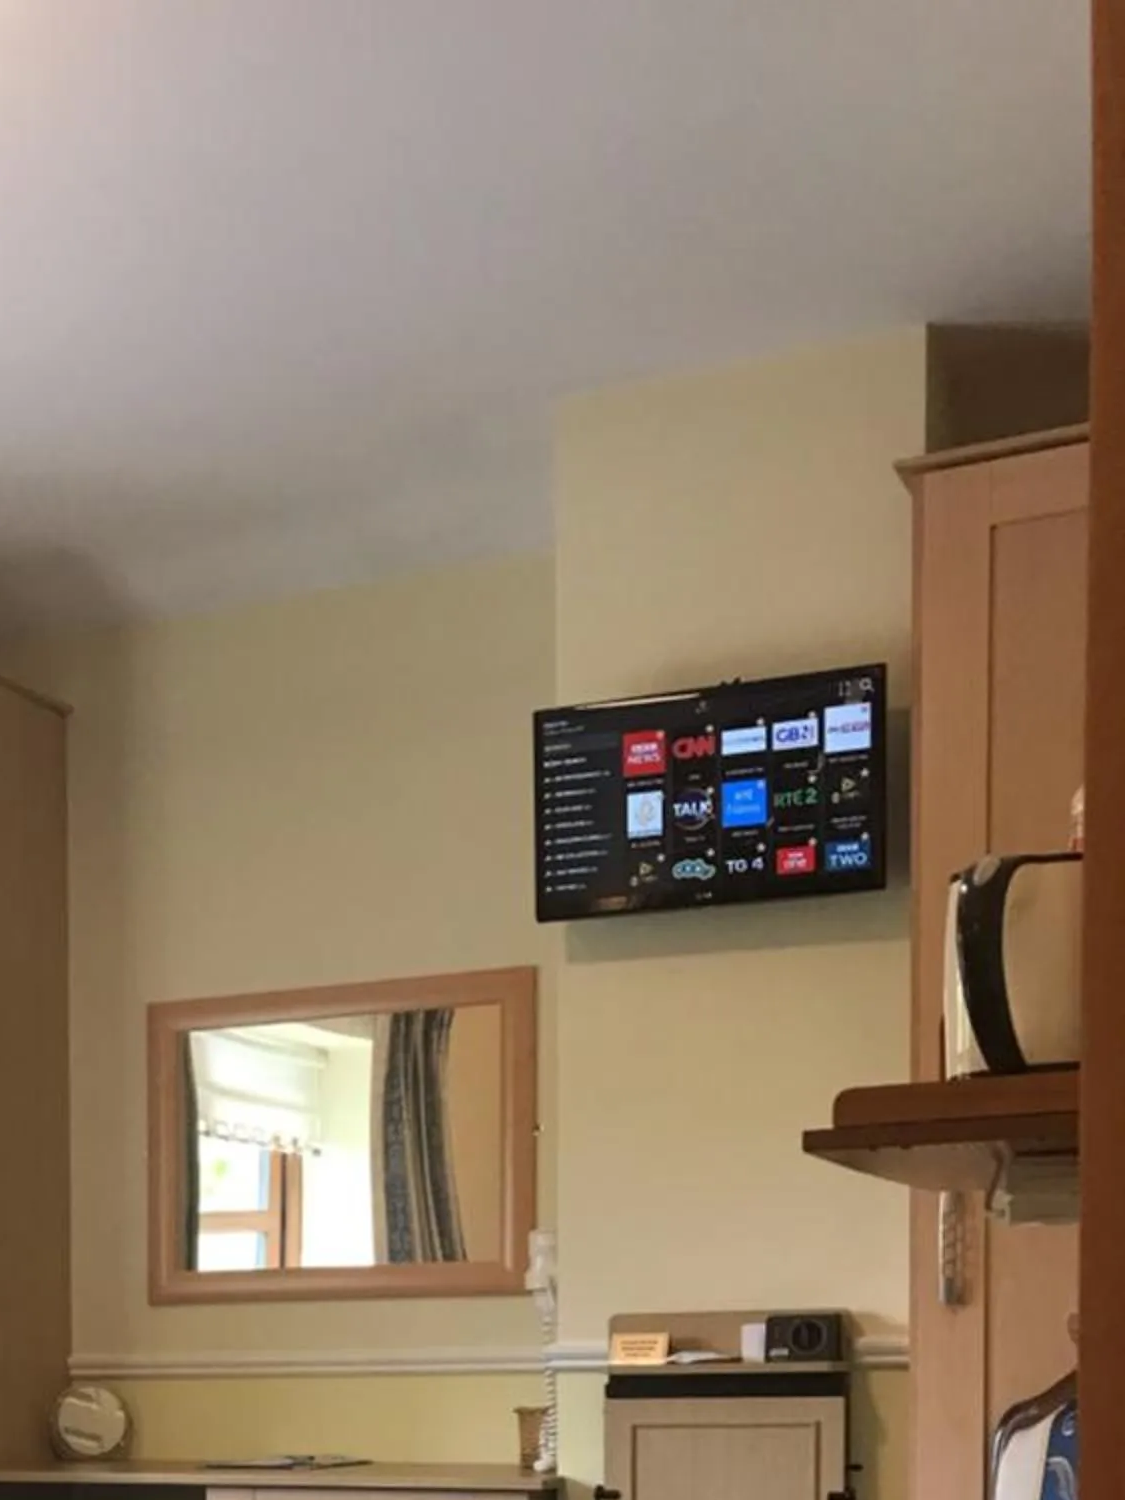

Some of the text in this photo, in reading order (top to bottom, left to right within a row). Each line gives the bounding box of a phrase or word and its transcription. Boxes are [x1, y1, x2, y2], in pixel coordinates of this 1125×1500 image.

[673, 737, 715, 758] CNN
[805, 786, 819, 804] 2
[751, 856, 764, 870] 4
[830, 853, 867, 867] TWO
